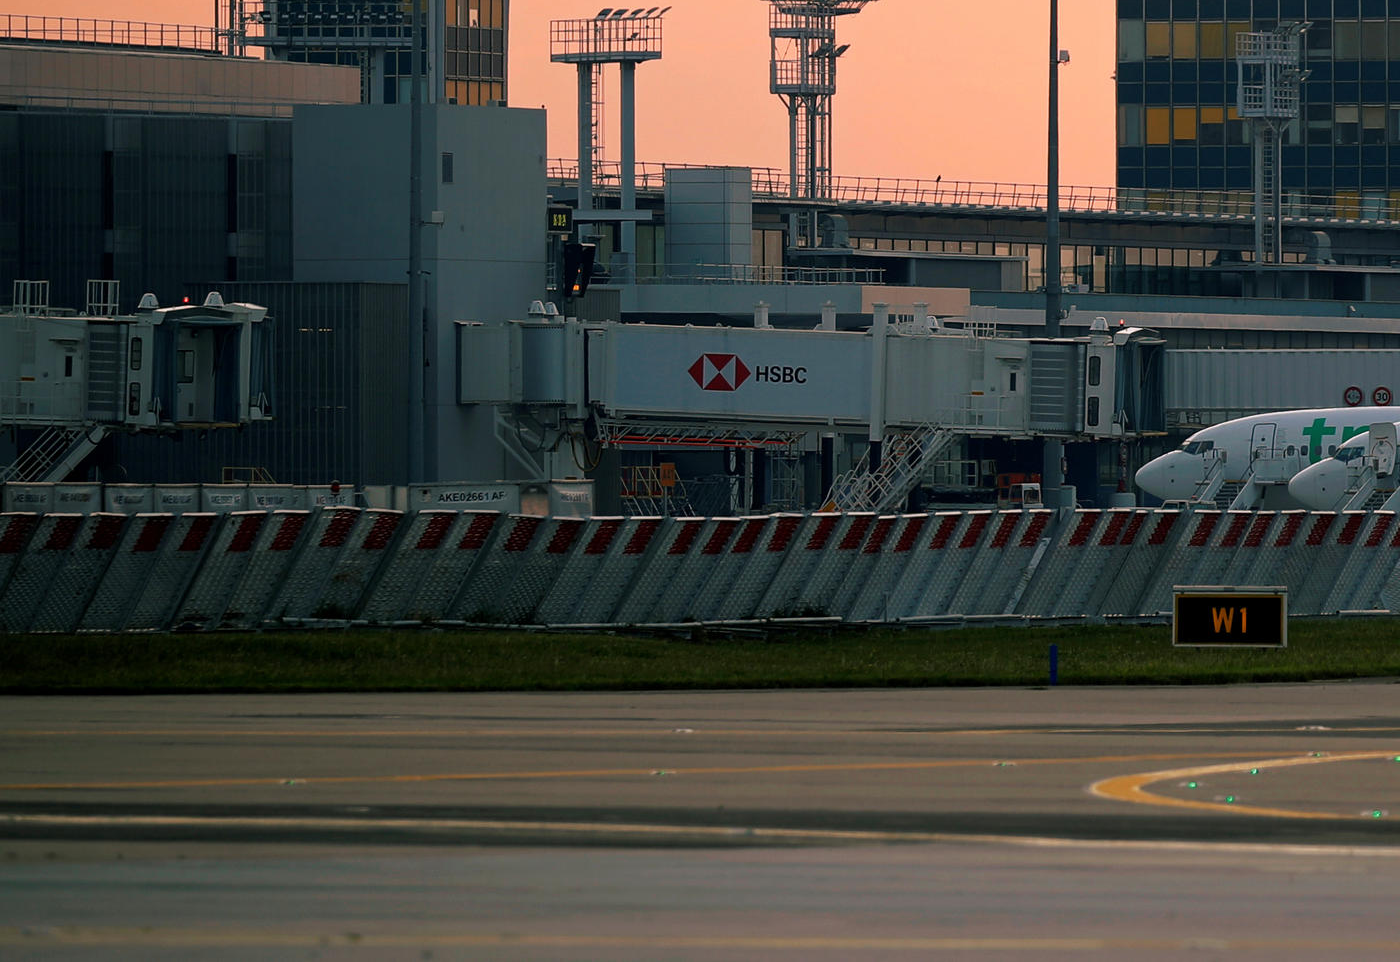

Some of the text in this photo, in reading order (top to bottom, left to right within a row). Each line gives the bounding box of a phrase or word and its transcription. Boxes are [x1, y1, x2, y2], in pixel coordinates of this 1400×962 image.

[755, 365, 807, 384] HSBC
[1376, 392, 1388, 401] 30
[438, 491, 505, 503] AKE02661 AF
[1211, 606, 1248, 634] W1
